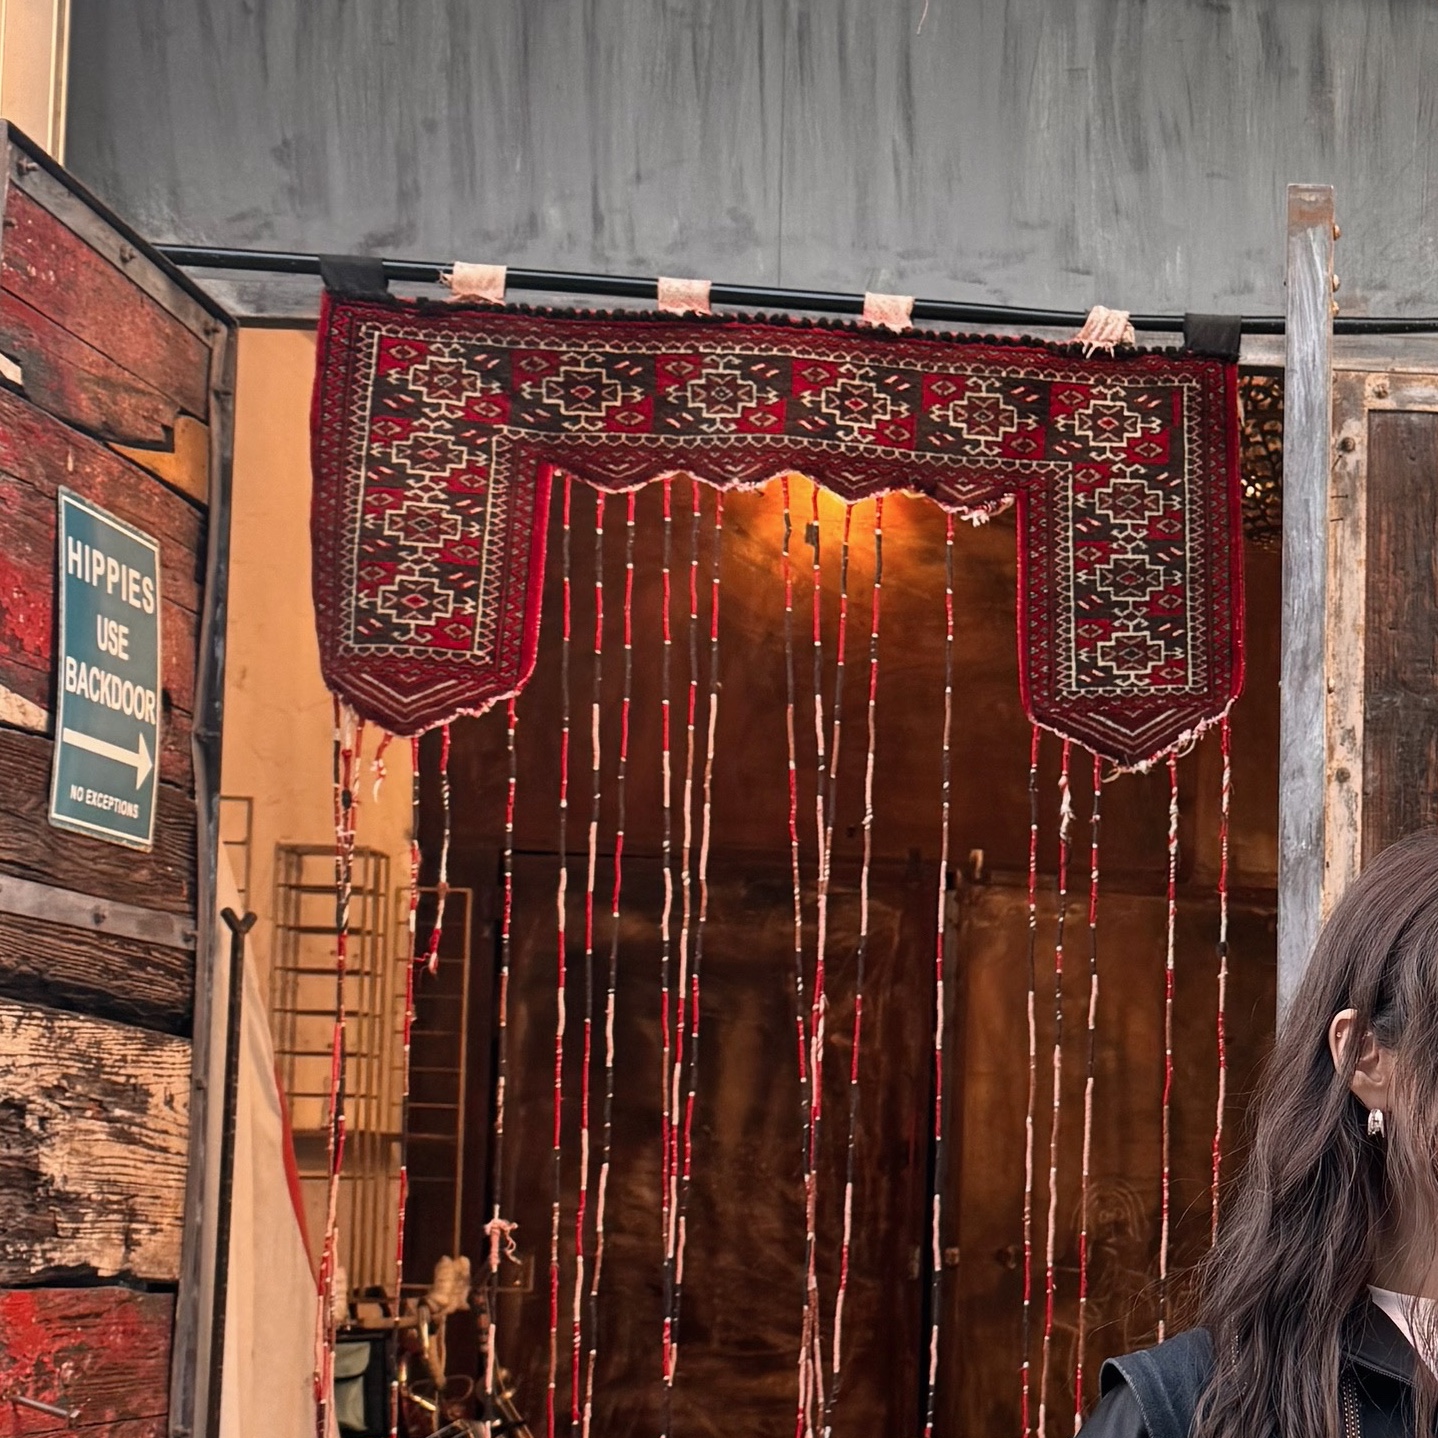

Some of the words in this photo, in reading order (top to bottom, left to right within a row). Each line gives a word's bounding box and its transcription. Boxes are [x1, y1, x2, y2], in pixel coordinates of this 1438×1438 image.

[67, 535, 155, 615] HIPPIES
[96, 613, 130, 661] USE
[65, 655, 156, 726] BACKDOOR
[70, 784, 84, 802] NO
[85, 788, 139, 819] EXCEPTIONS
